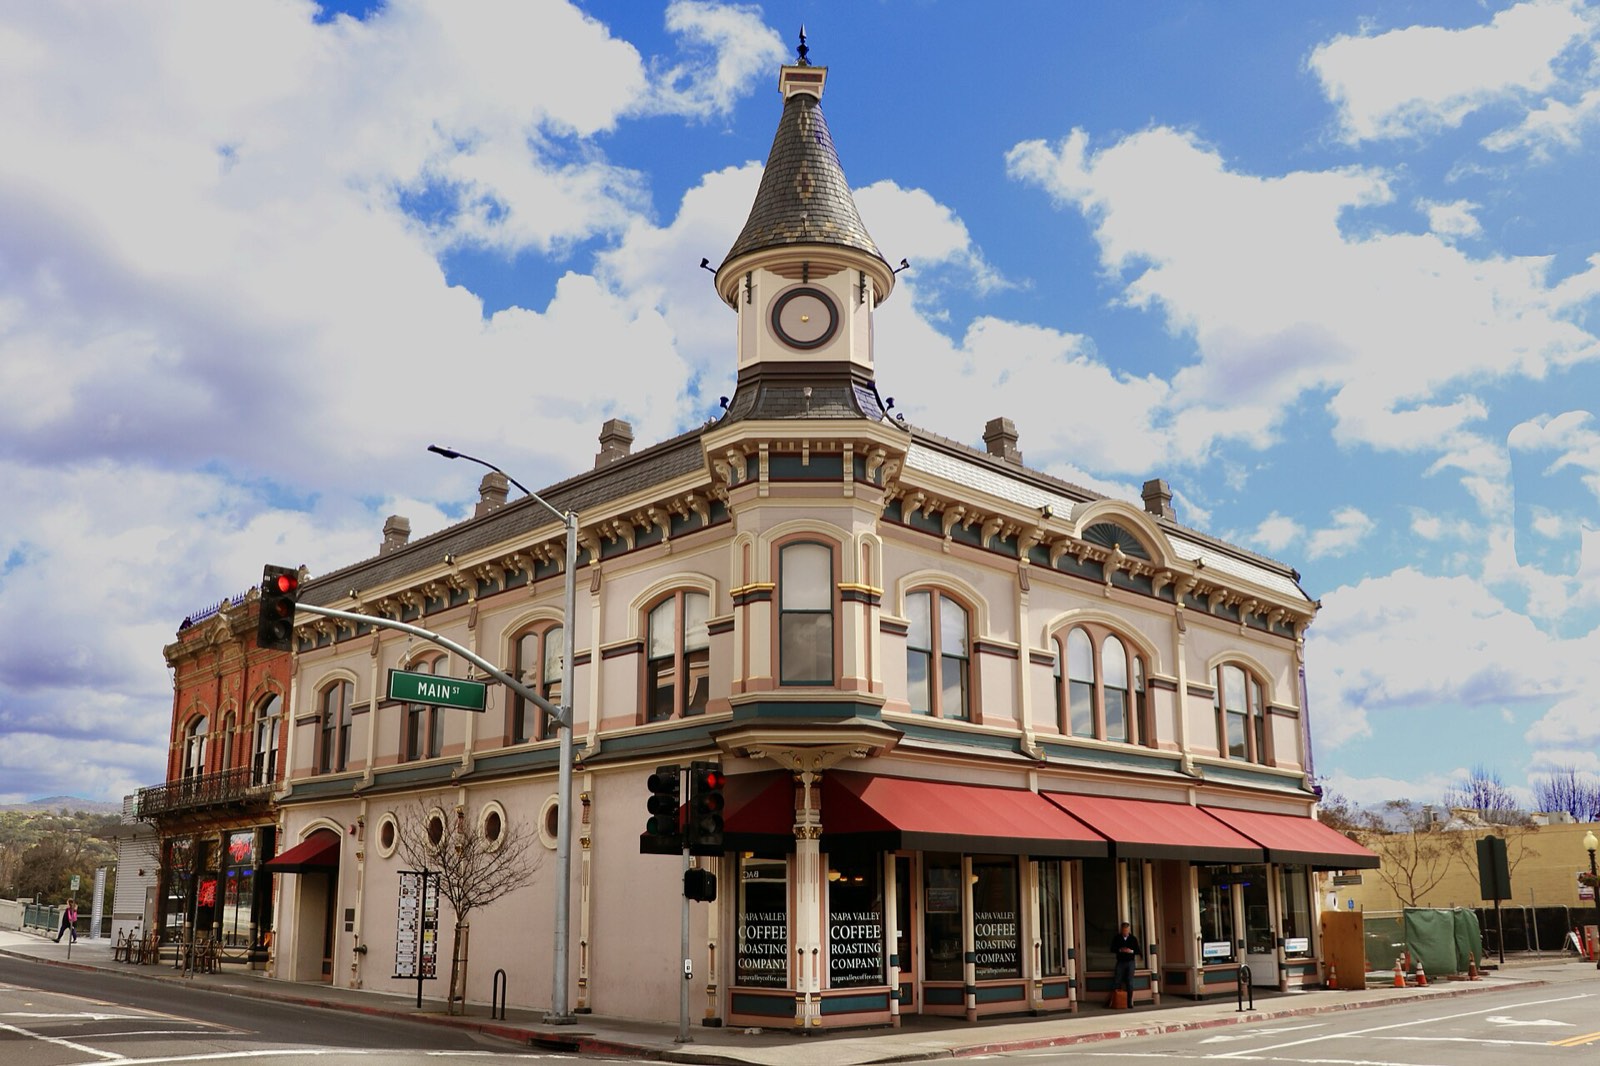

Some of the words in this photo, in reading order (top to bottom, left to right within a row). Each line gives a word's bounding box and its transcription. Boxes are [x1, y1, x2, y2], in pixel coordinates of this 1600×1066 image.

[417, 682, 450, 699] MAIN
[452, 686, 460, 695] ST
[739, 912, 758, 921] NAPA
[759, 912, 786, 921] VALLEY
[831, 912, 851, 921] NAPA
[853, 911, 881, 921] VALLEY
[975, 911, 992, 920] NAPA
[993, 911, 1015, 920] VALLEY
[738, 925, 787, 940] COFFEE
[831, 924, 881, 940] COFFEE
[975, 923, 1016, 937] COFFEE
[739, 943, 787, 955] ROASTING
[831, 942, 881, 955] ROASTING
[975, 939, 1016, 950] ROASTING
